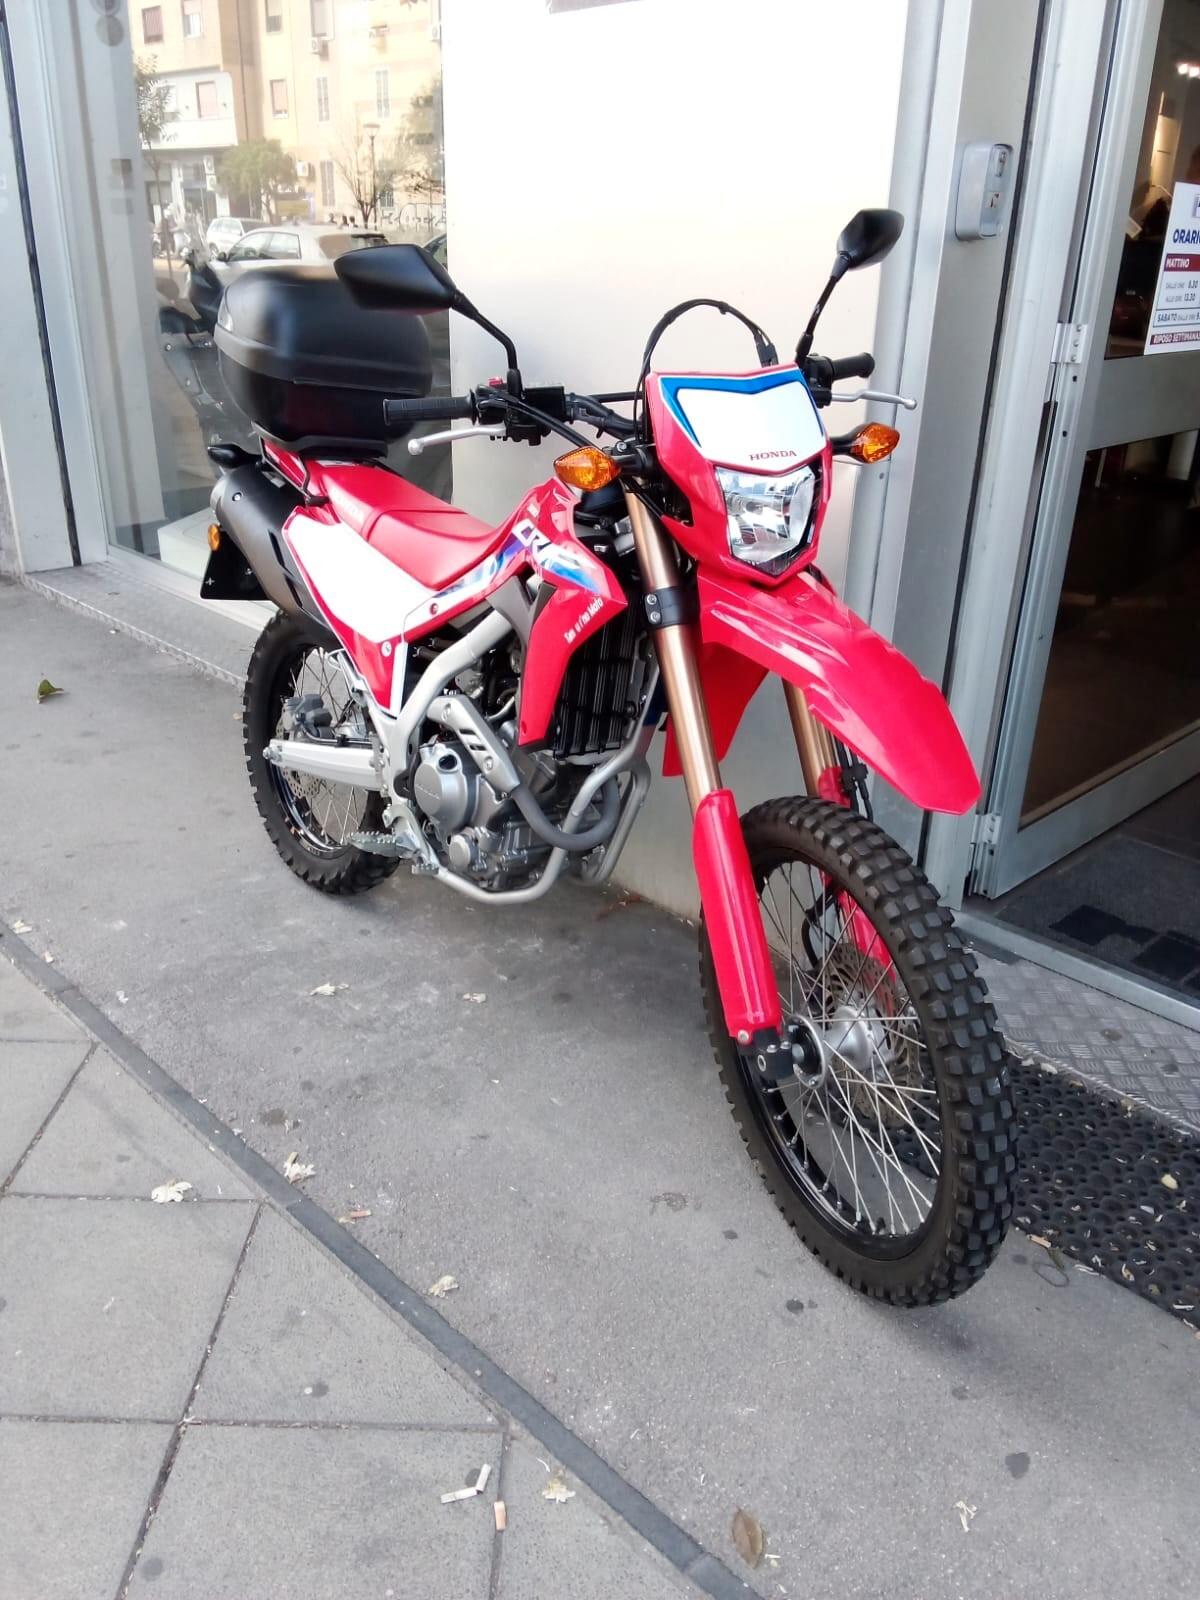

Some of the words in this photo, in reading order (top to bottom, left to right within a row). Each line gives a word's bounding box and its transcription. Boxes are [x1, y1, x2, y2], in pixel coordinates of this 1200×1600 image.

[1173, 229, 1200, 244] ORARI
[1166, 258, 1190, 268] MATTINO
[1158, 313, 1177, 322] SABATO
[1153, 333, 1172, 344] RIPOSO
[749, 450, 797, 461] HONDA
